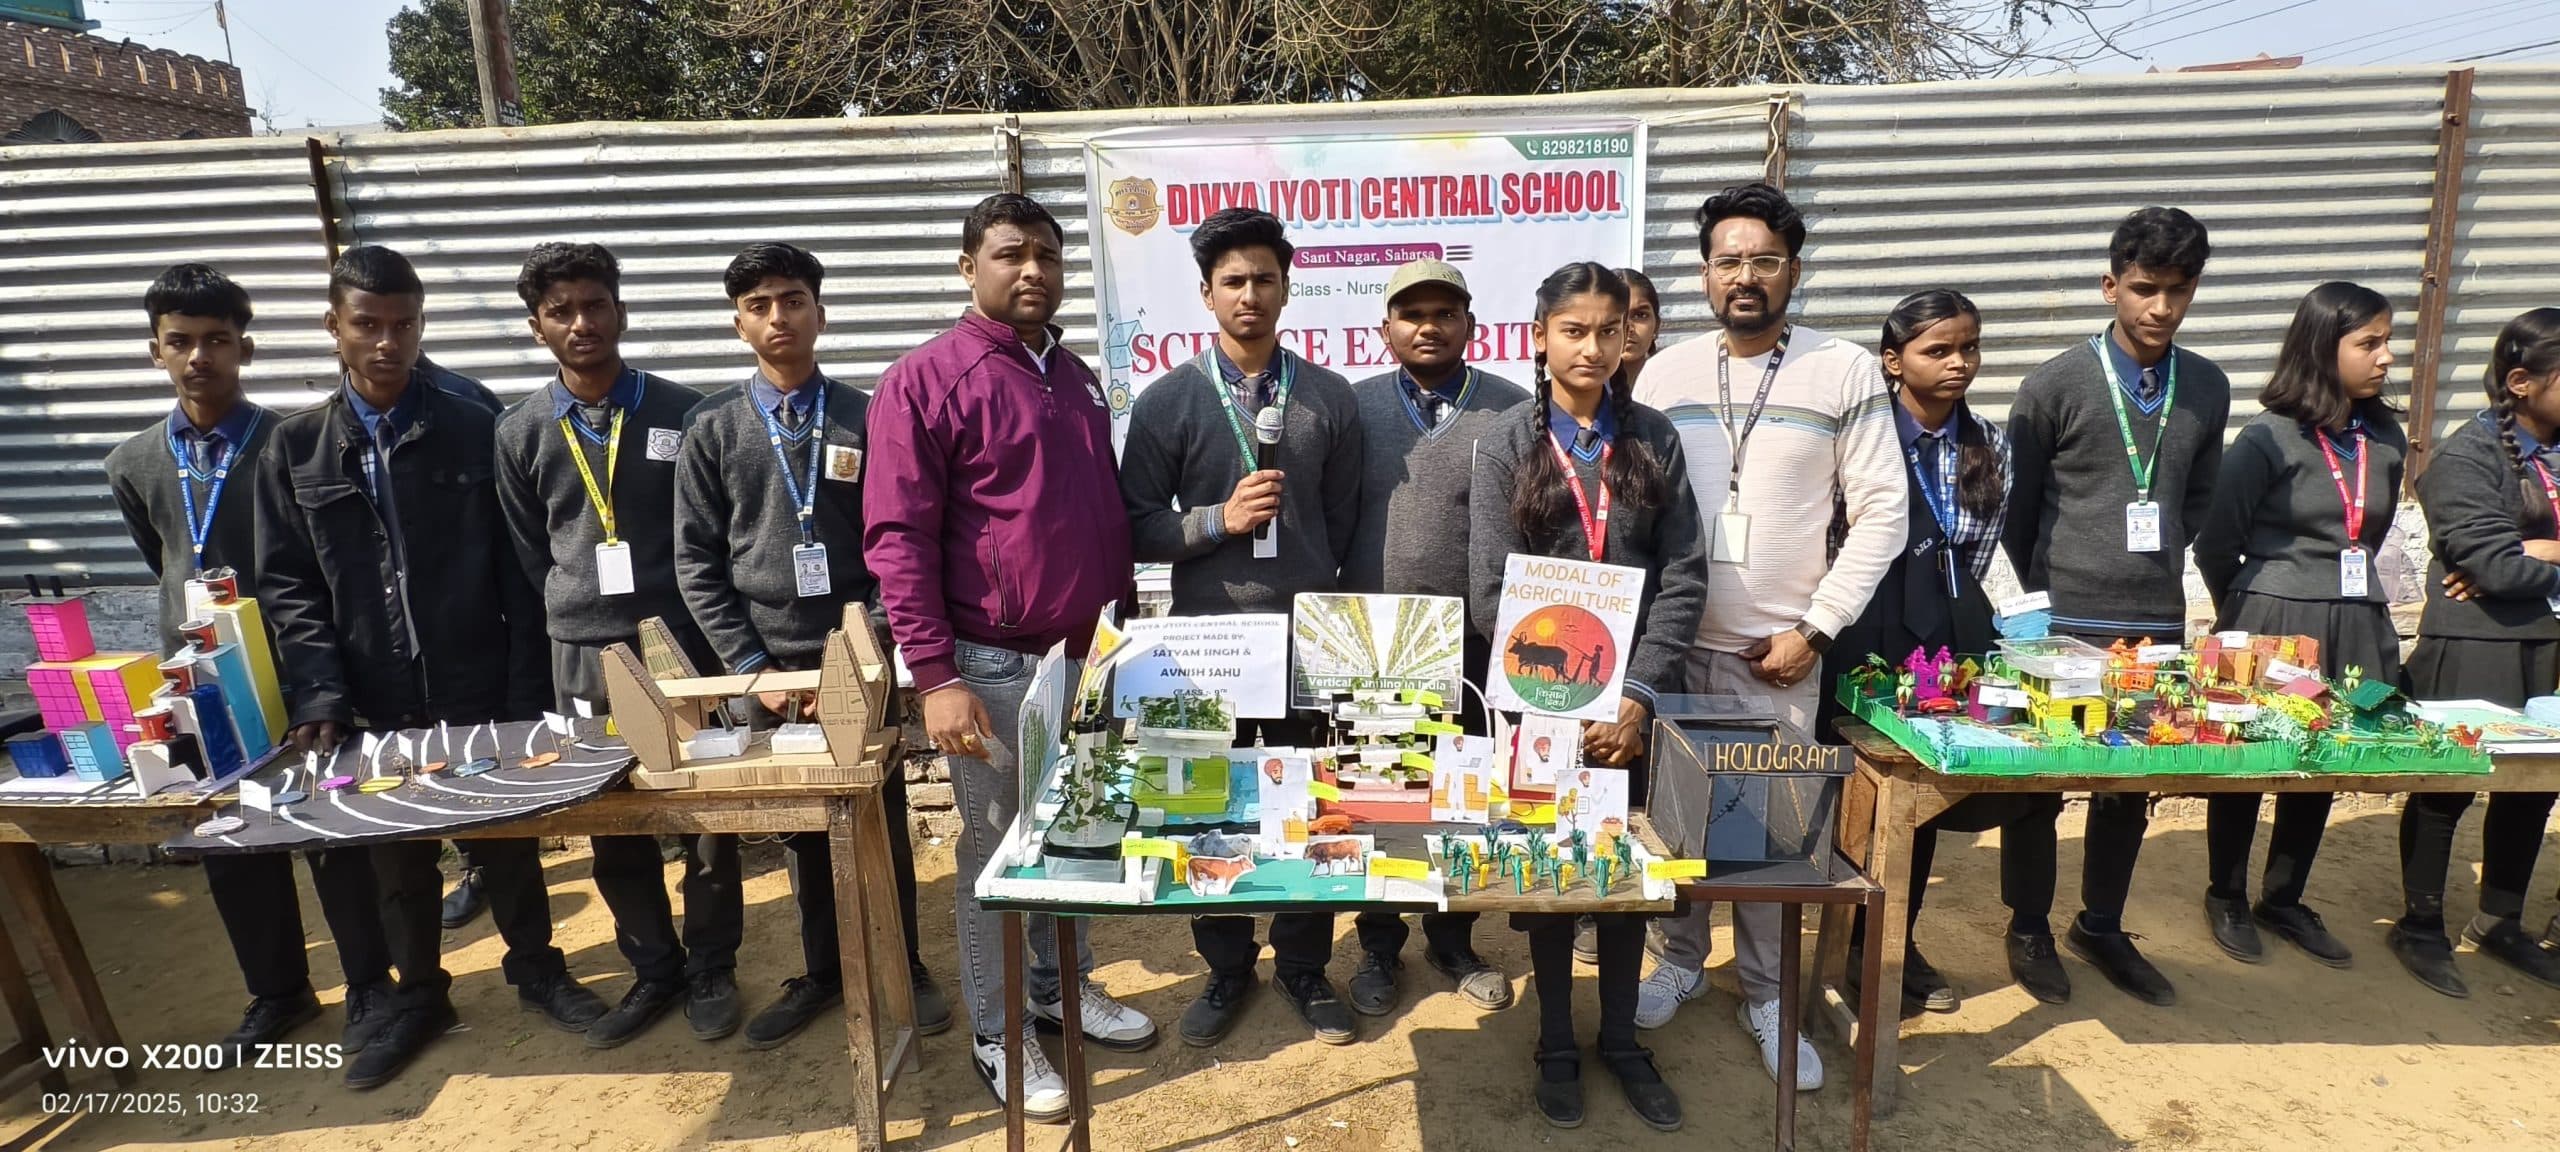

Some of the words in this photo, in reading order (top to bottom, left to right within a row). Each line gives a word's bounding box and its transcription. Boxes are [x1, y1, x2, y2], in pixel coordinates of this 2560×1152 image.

[1542, 138, 1628, 156] 8298218190
[1360, 174, 1494, 220] CENTRAL
[1502, 170, 1621, 216] SCHOOL
[1301, 251, 1331, 264] Sant
[1335, 250, 1380, 265] Nagar,
[1385, 248, 1435, 262] Saharsa
[1290, 282, 1331, 297] Class
[1524, 561, 1591, 585] MODAL
[1598, 571, 1623, 588] OF
[1505, 583, 1633, 614] AGRICULTURE
[1152, 649, 1200, 658] SATYAM
[1204, 648, 1240, 657] SINGH
[1243, 648, 1251, 656] &
[1160, 667, 1205, 678] AVNISH
[1208, 667, 1241, 678] SAHU
[1308, 676, 1350, 688] Vertical
[1716, 743, 1838, 771] HOLOGRAM
